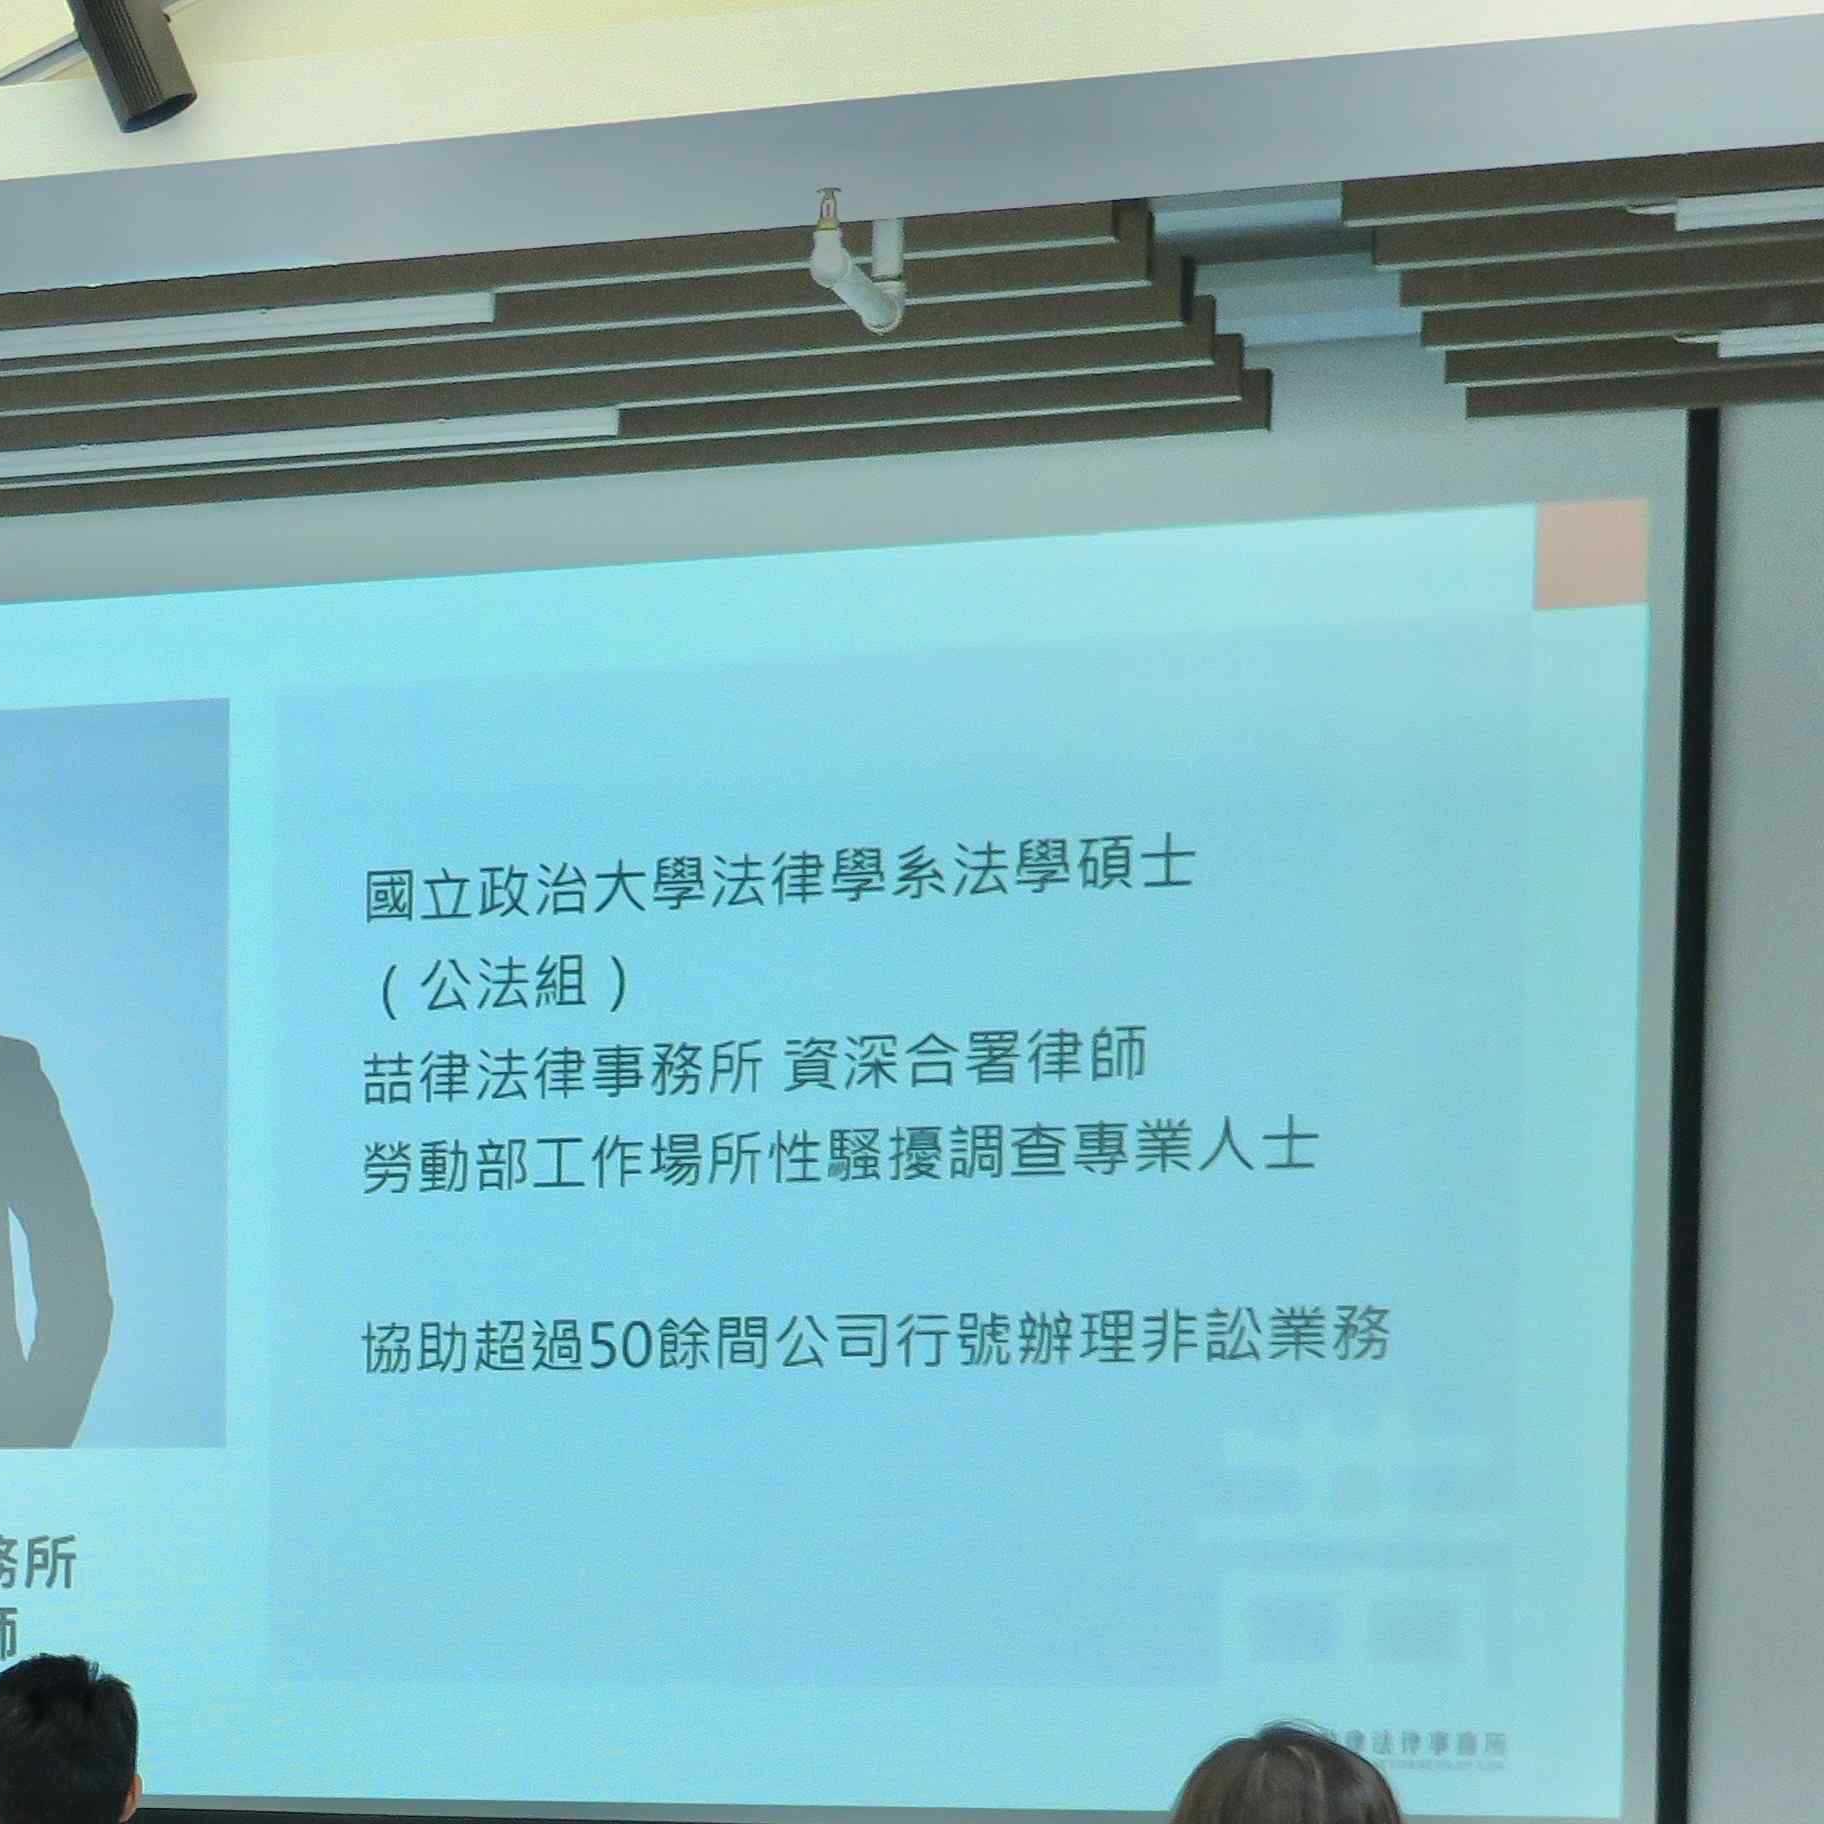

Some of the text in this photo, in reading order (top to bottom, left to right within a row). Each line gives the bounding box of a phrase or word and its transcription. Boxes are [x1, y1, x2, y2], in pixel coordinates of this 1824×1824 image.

[364, 831, 1198, 923] 國立政治大學法律學系法學碩士
[362, 1024, 1148, 1105] 喆律法律事務所 資深合署律師
[362, 1113, 1320, 1195] 勞動部工作場所性騷擾調查專業人士
[360, 1303, 1392, 1375] 協助超過50餘間公司行號辦理非訟業務
